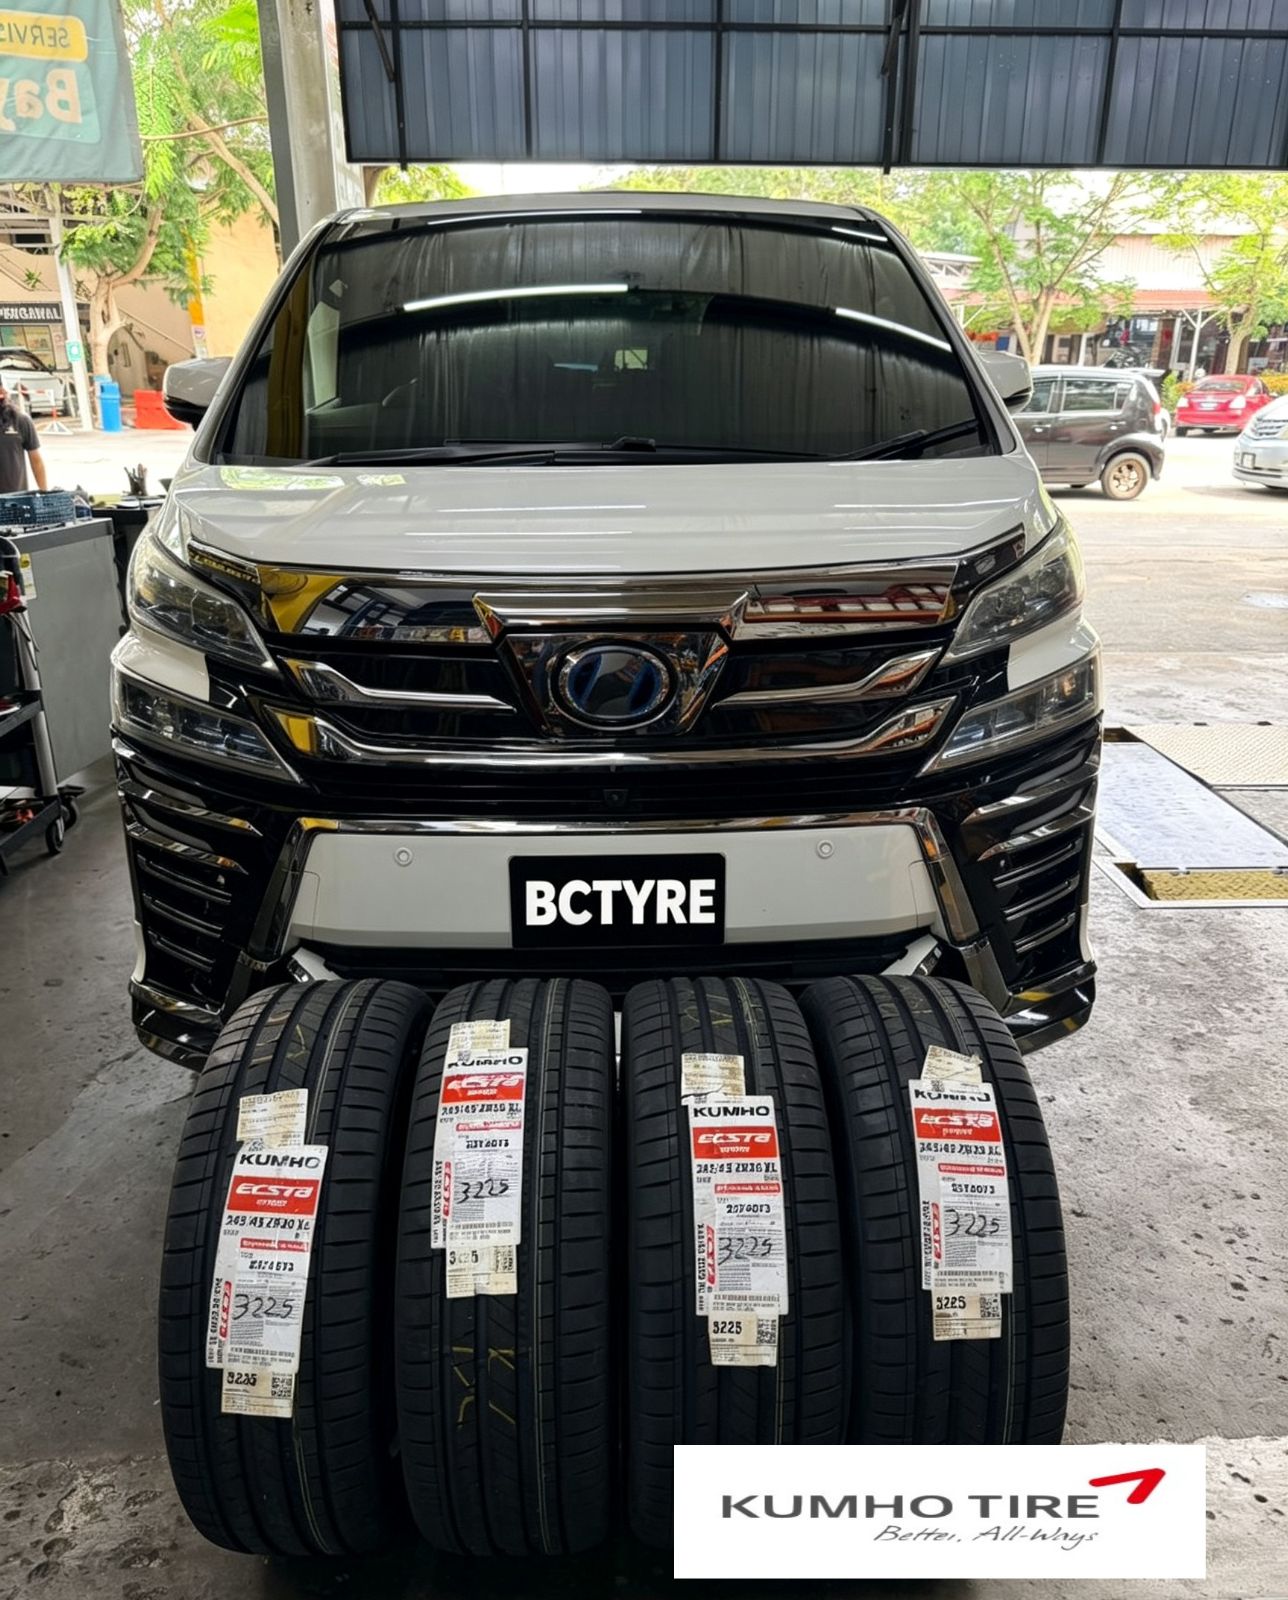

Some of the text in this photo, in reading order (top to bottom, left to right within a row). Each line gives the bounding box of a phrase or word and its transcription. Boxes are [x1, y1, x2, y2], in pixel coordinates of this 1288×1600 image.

[693, 1105, 770, 1118] KUMHO
[239, 1153, 321, 1169] KUMHO
[456, 1178, 509, 1204] 3225
[944, 1208, 1000, 1238] 3225
[718, 1236, 772, 1266] 3225
[231, 1293, 297, 1321] 3225
